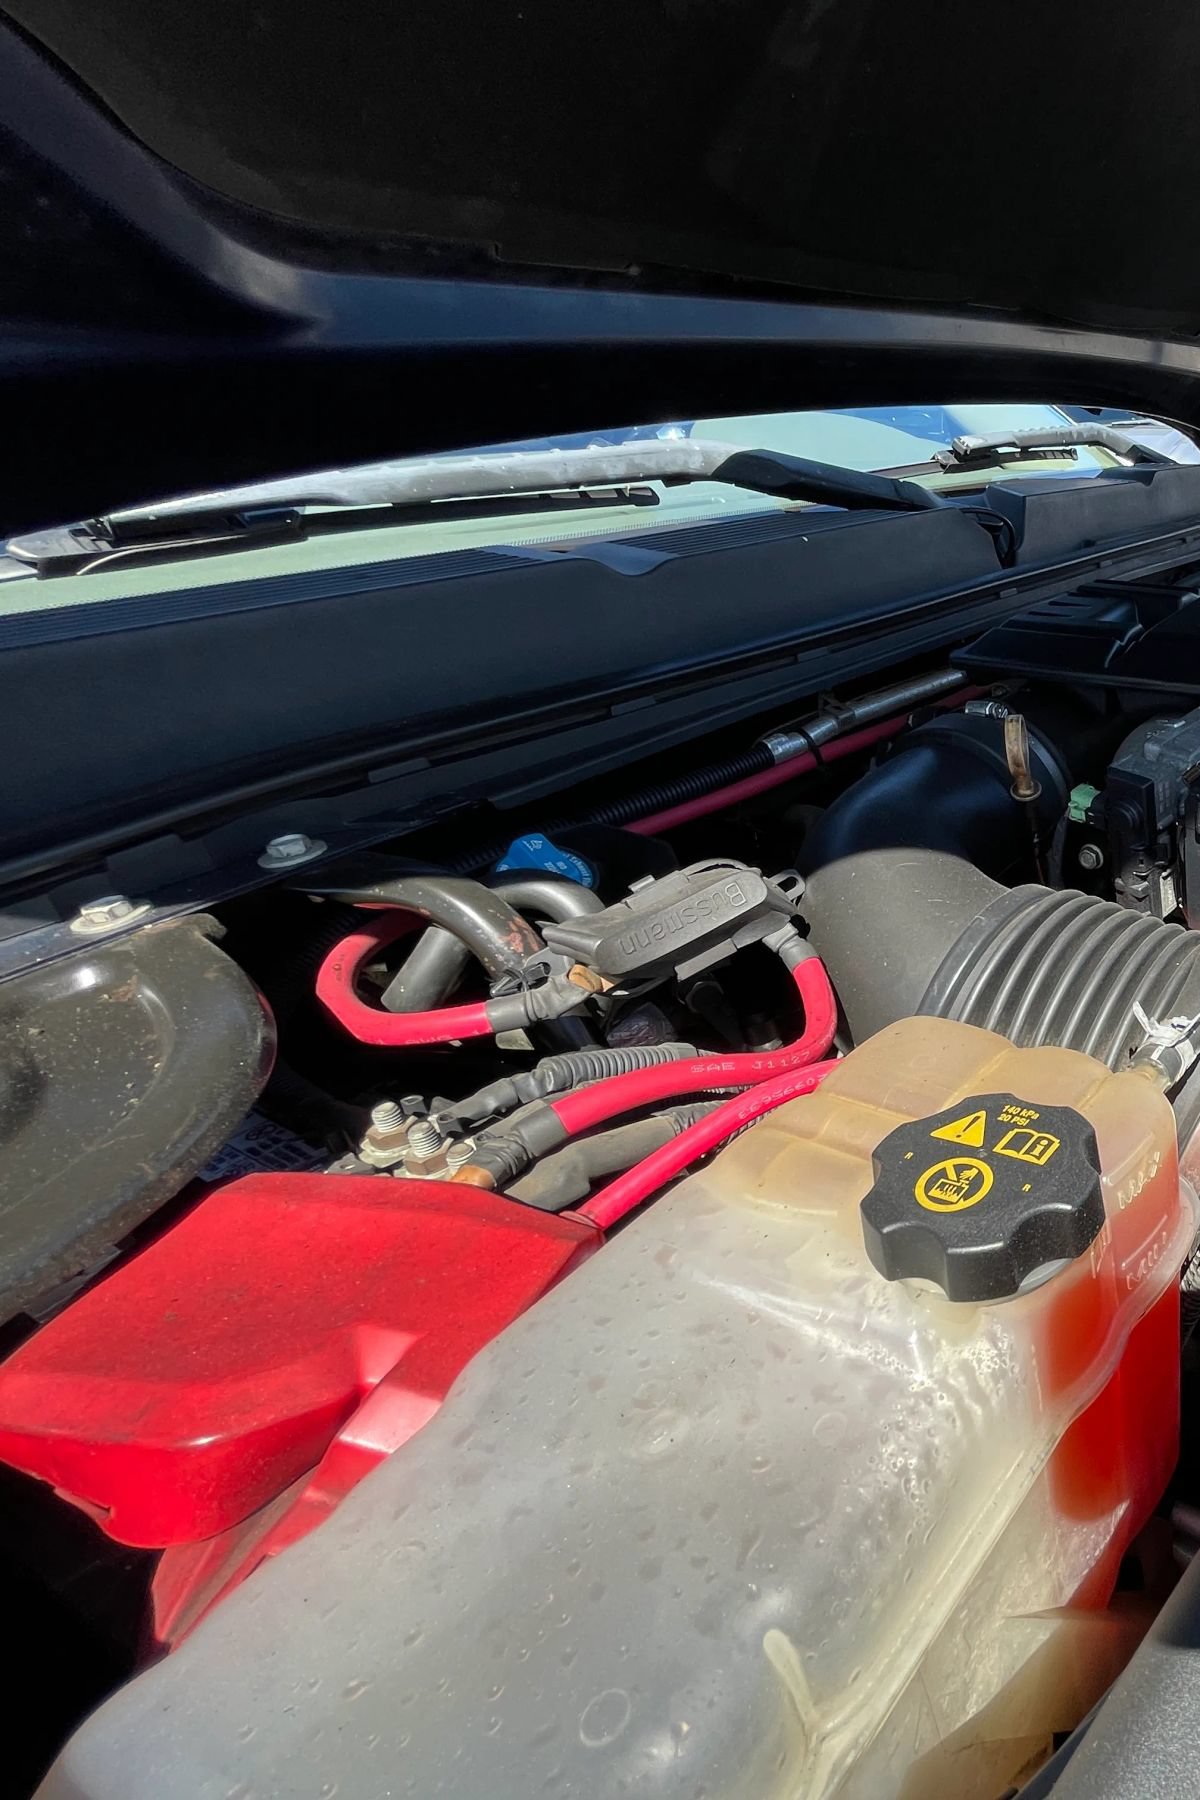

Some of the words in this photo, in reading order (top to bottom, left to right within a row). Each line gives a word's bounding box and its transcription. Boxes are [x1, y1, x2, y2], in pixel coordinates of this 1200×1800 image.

[618, 882, 747, 954] Bussmann
[691, 1061, 736, 1073] SAE
[1002, 1104, 1019, 1116] 140
[1019, 1108, 1040, 1120] kPa
[997, 1113, 1012, 1122] 20
[1012, 1116, 1031, 1127] PSI
